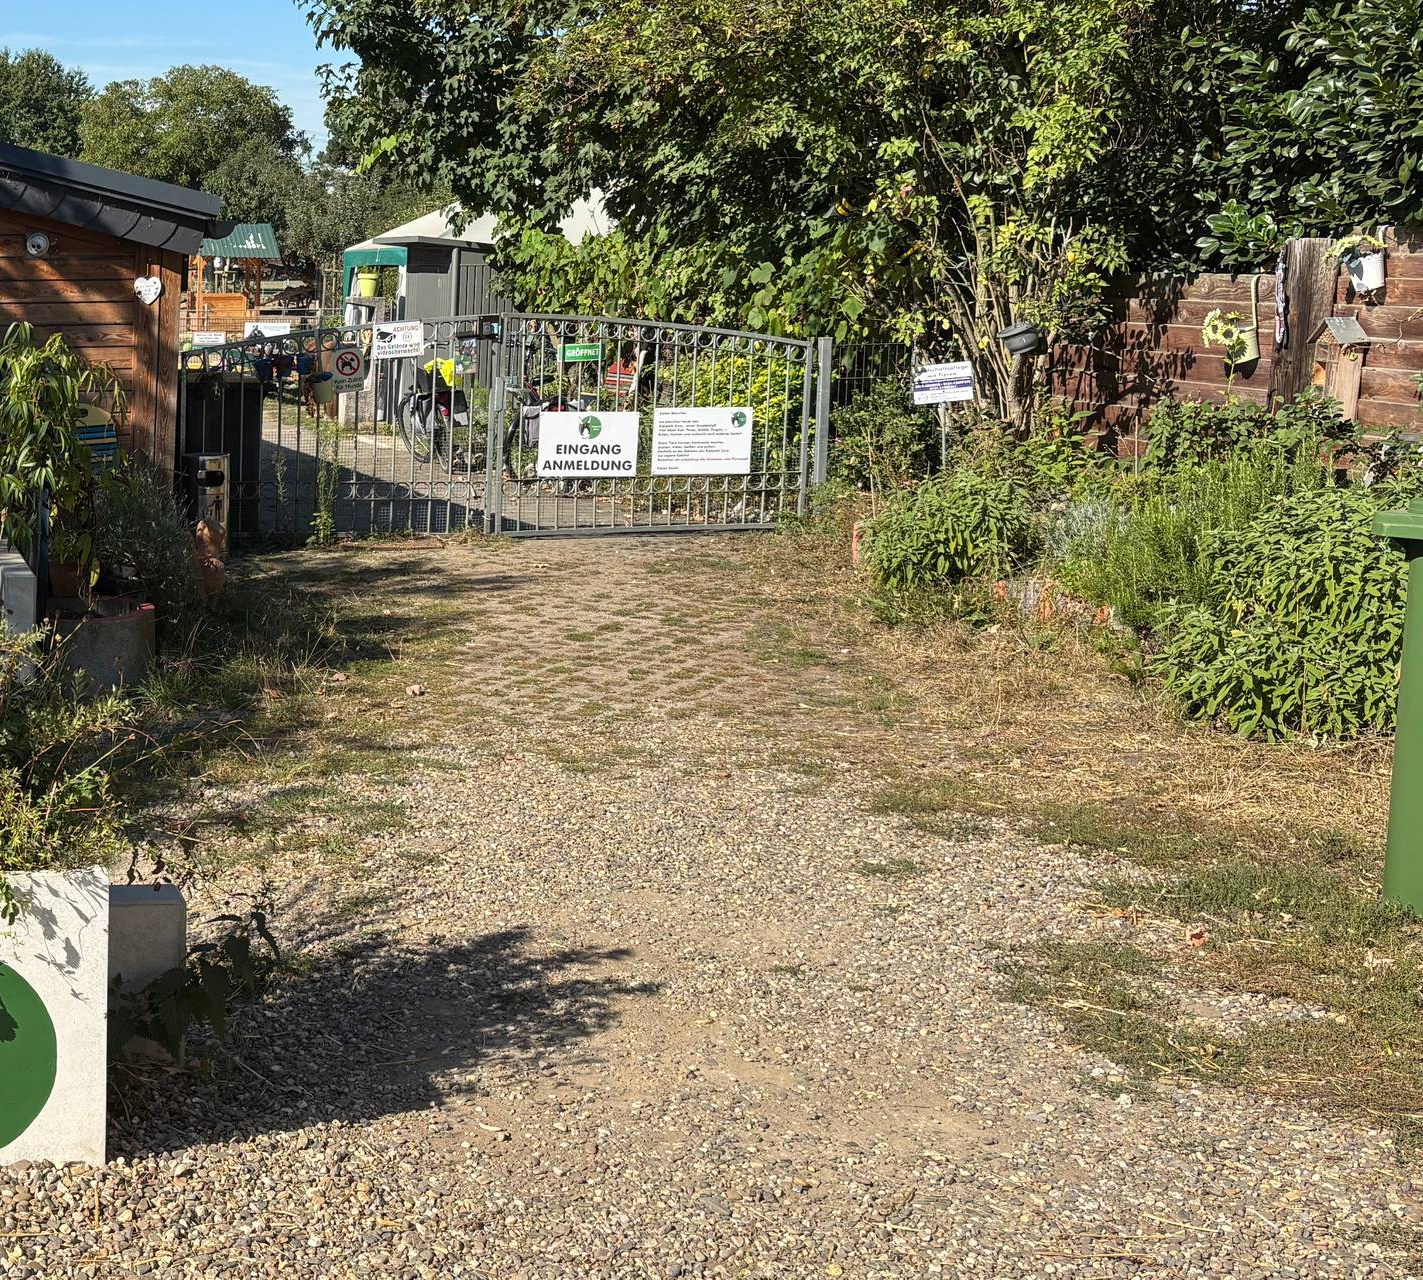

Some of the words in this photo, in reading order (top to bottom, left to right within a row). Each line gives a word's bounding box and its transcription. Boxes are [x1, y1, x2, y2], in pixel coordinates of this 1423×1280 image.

[566, 346, 599, 357] GEÖFFNET
[556, 444, 622, 455] EINGANG
[542, 460, 633, 471] ANMELDUNG
